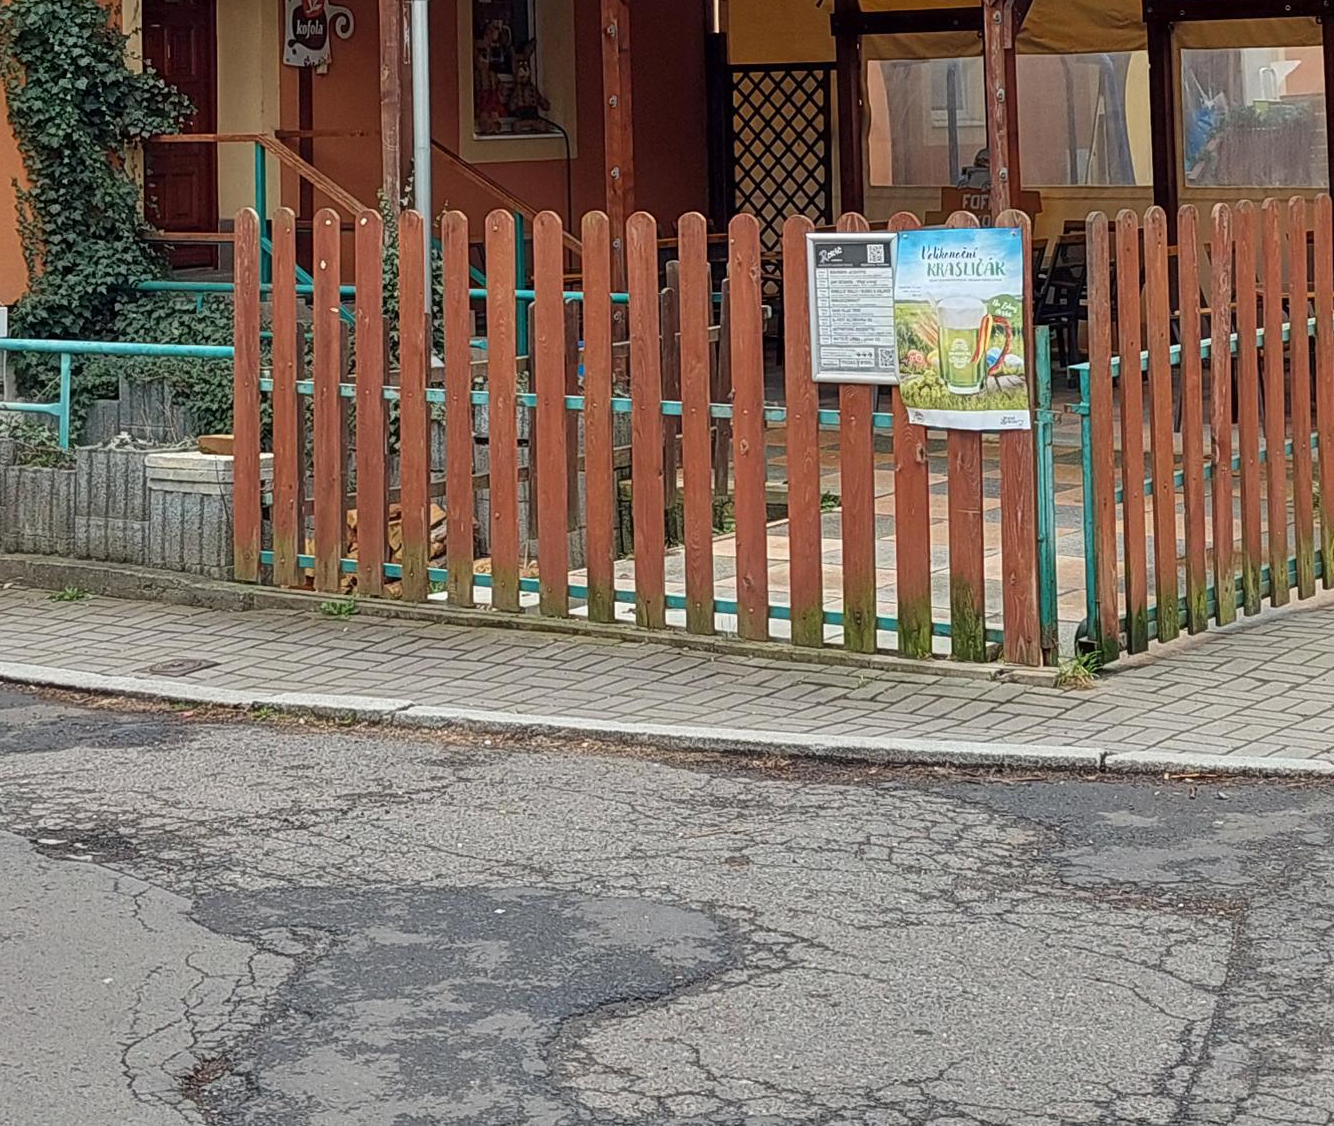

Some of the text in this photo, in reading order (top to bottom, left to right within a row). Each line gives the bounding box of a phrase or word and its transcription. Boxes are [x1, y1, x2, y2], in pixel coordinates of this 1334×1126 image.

[962, 194, 992, 210] FOF
[921, 245, 978, 260] Velikonoční
[927, 257, 1007, 278] KRASLIČÁK
